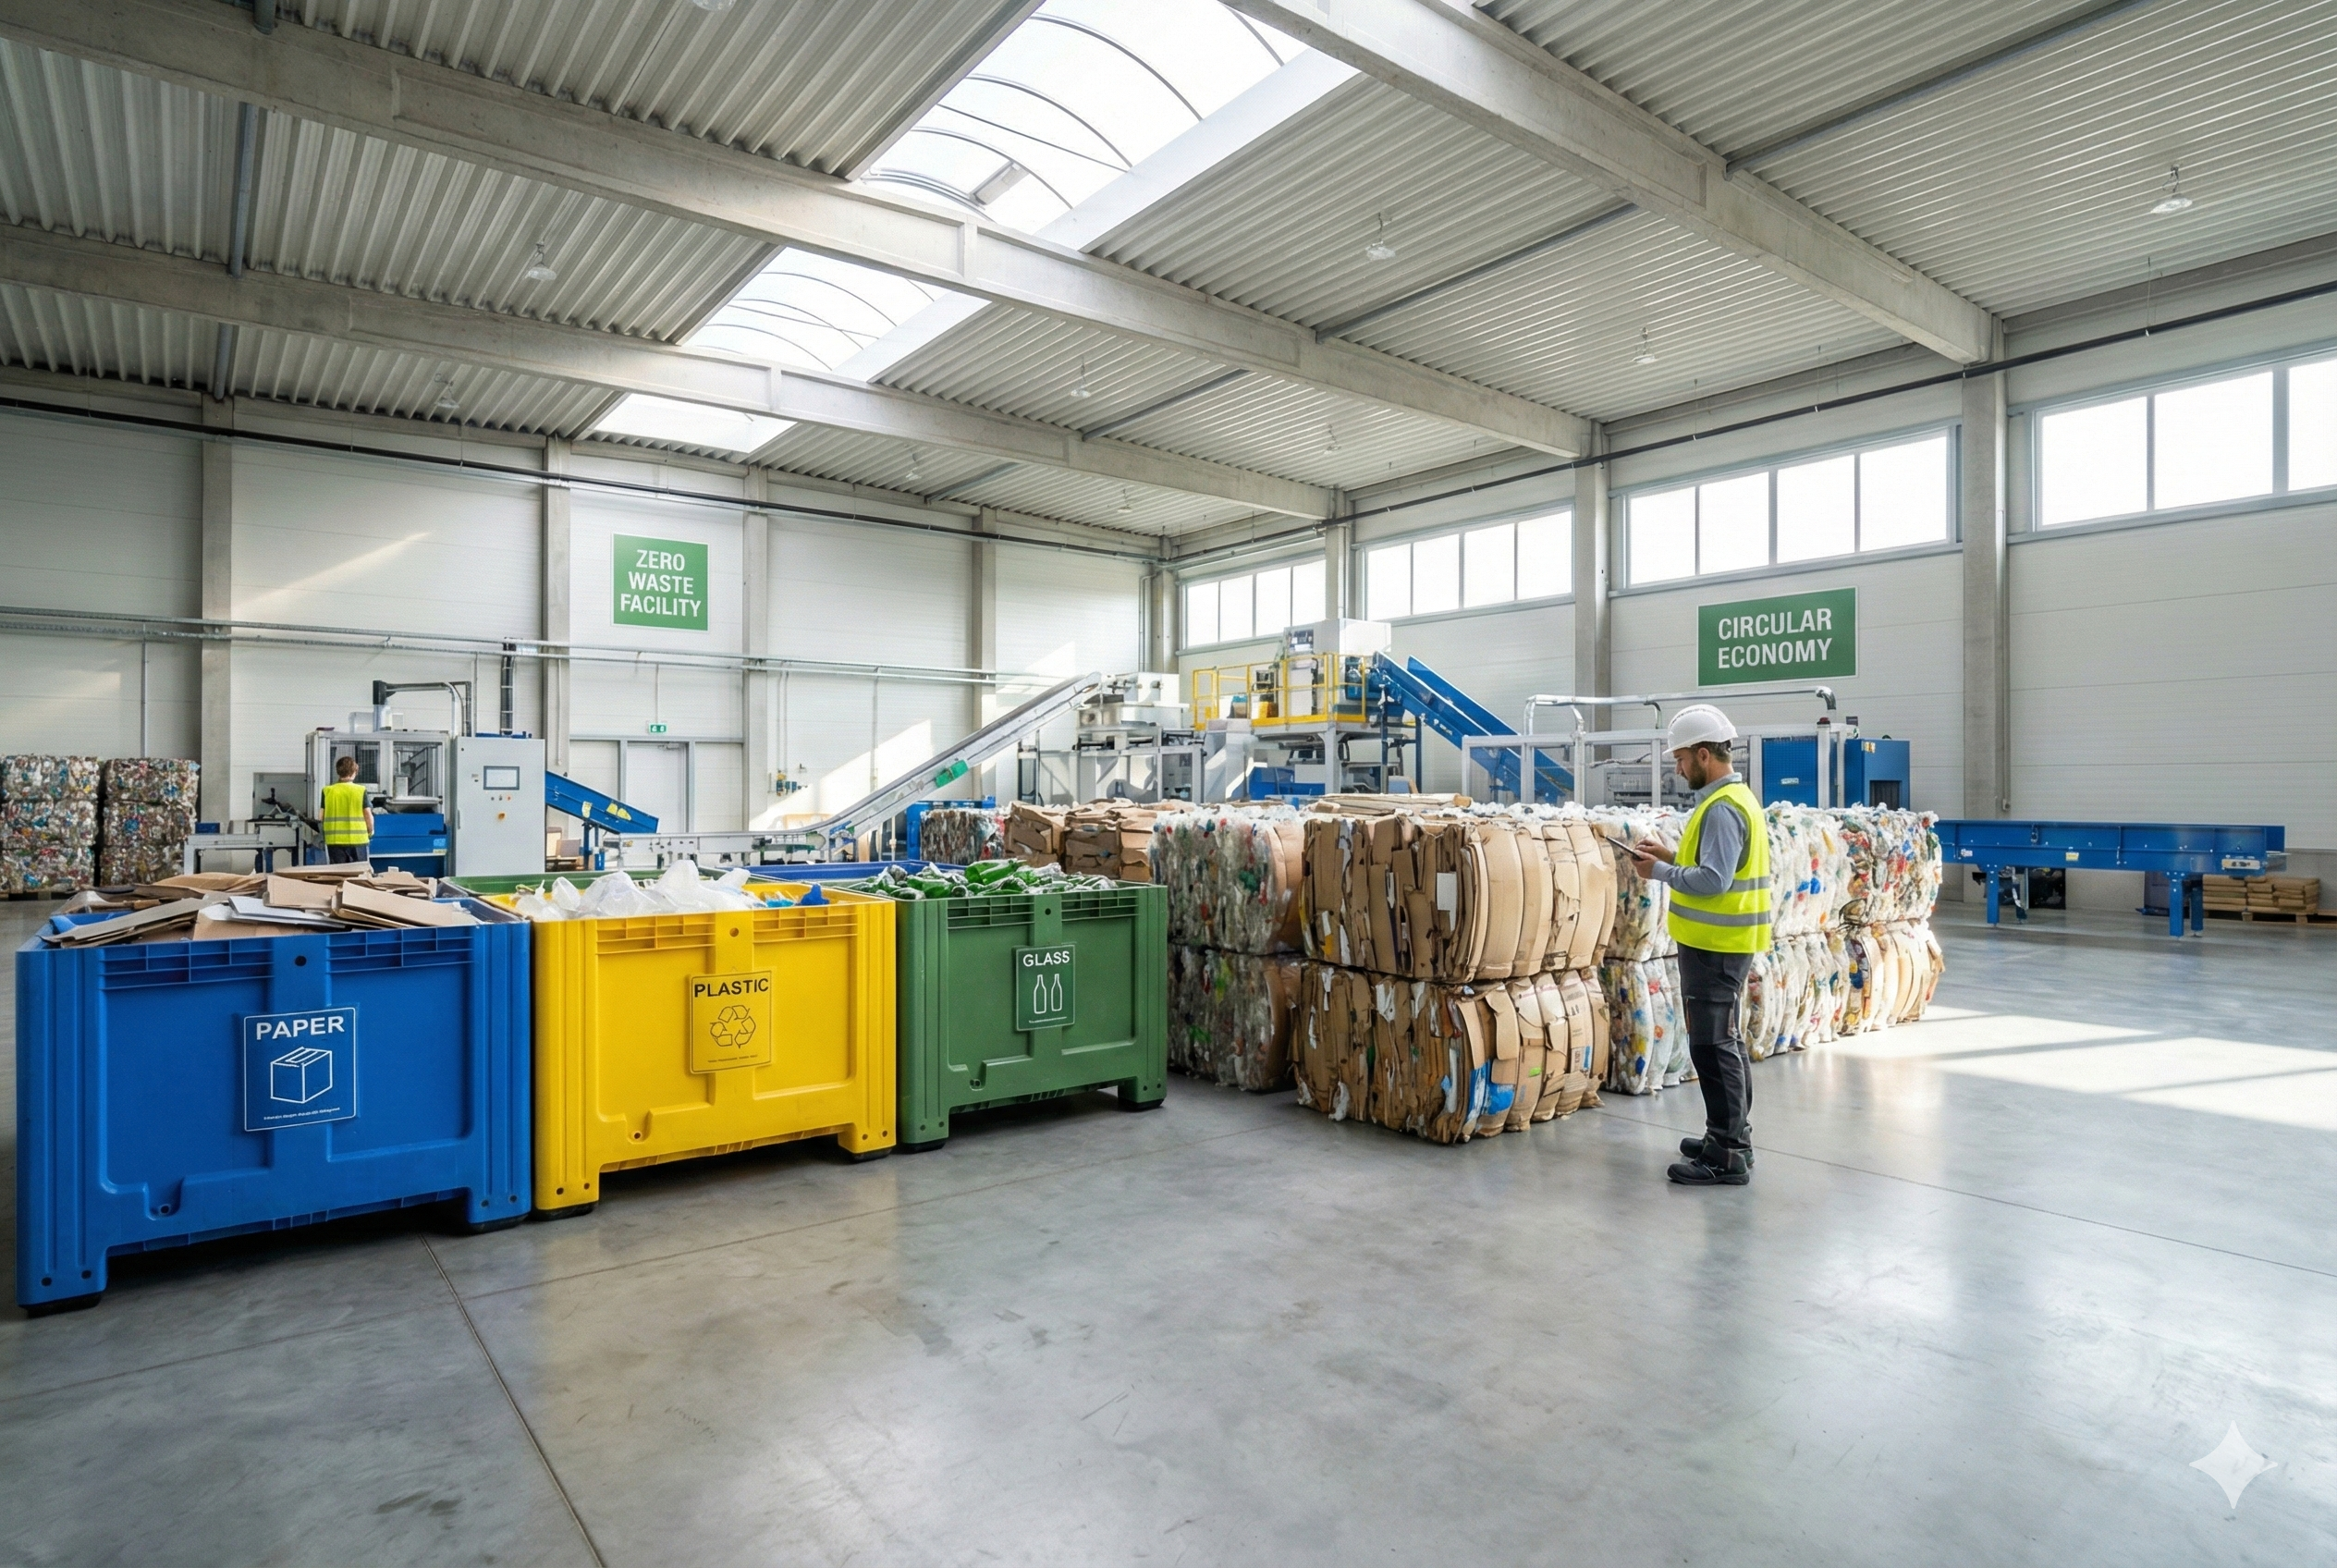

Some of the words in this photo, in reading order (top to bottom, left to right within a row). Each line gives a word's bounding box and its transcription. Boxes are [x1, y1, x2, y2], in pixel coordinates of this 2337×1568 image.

[636, 549, 685, 571] ZERO
[628, 570, 694, 594] WASTE
[620, 593, 702, 618] FACILITY
[1718, 607, 1832, 640] CIRCULAR
[1718, 638, 1832, 668] ECONOMY
[694, 978, 769, 998] PLASTIC
[256, 1016, 345, 1040] PAPER
